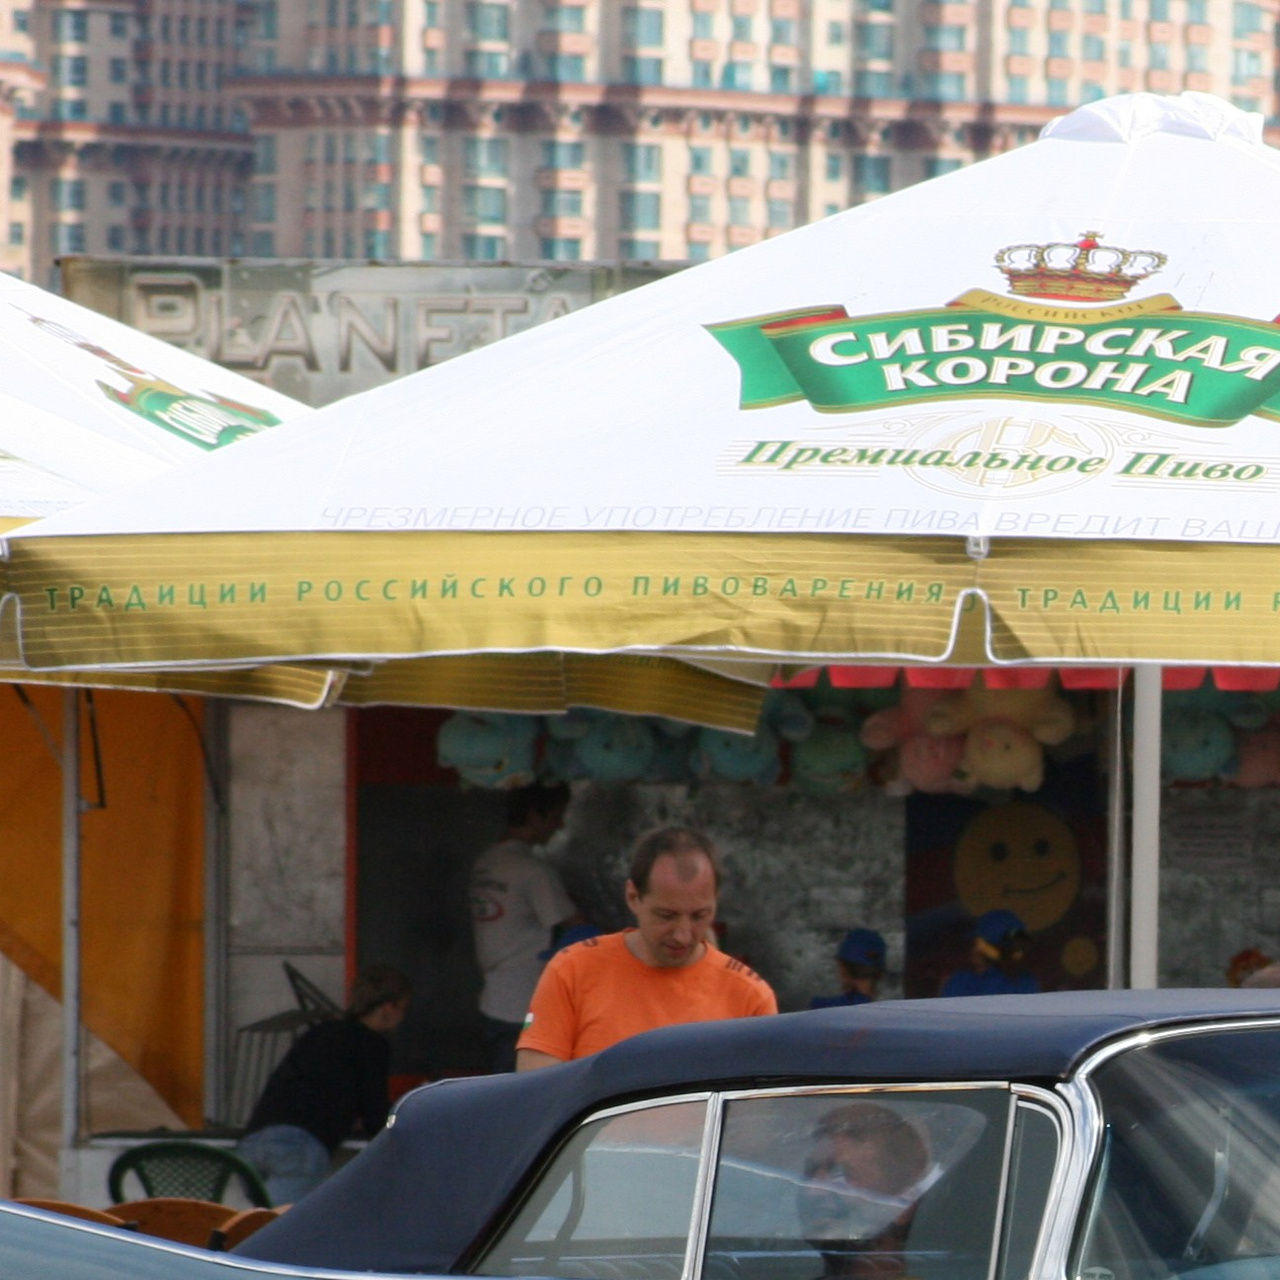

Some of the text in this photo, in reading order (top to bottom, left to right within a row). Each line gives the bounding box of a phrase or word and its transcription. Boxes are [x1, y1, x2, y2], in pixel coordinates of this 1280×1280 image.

[880, 355, 1194, 405] КОРОНА
[738, 440, 1266, 482] Премиальное Пиво
[320, 505, 565, 529] ЧРЕЗМЕРНОЕ
[580, 505, 873, 530] УПОТРЕБЛЕНИЕ
[884, 508, 981, 531] ПИВА
[995, 510, 1171, 537] ВРЕДИТ
[44, 573, 944, 613] ТРАДИЦИИ РОССИЙСКОГО ПИВОВАРЕНИЯ
[1018, 587, 1243, 615] ТРАДИЦИИ
